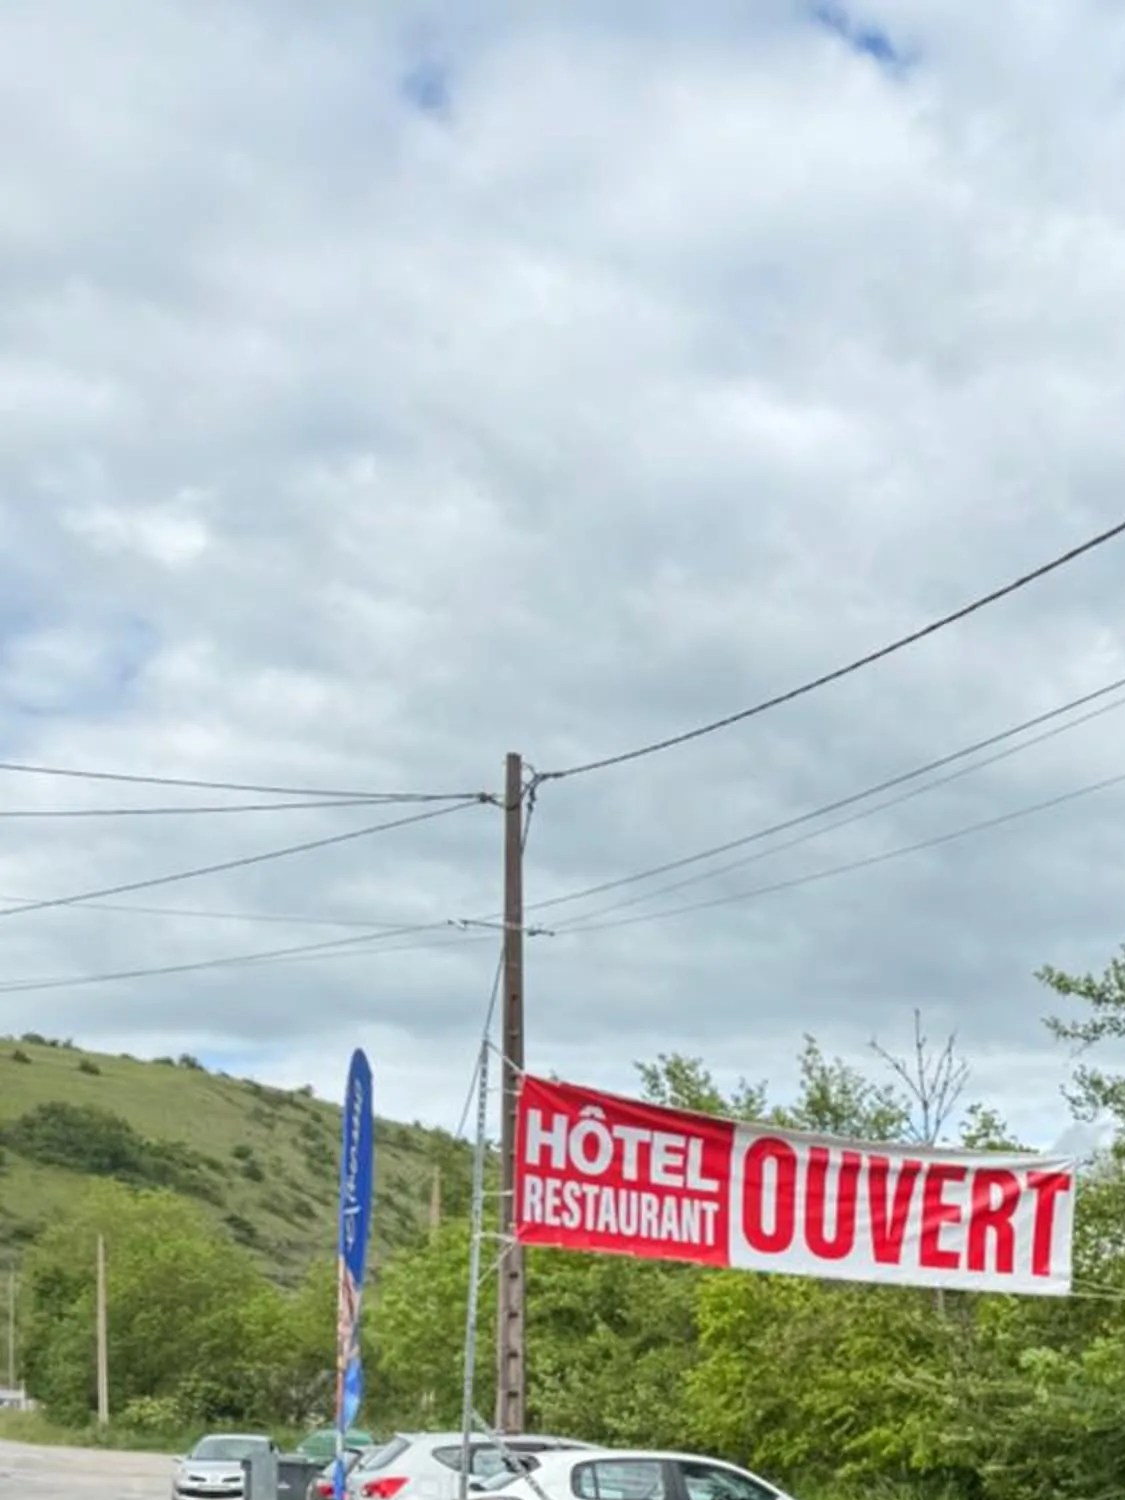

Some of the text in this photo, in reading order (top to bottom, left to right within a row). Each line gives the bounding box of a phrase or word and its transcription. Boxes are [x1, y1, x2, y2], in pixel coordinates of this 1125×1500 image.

[522, 1174, 719, 1247] RESTAURANT
[524, 1105, 1071, 1277] HÔTEL OUVERT
